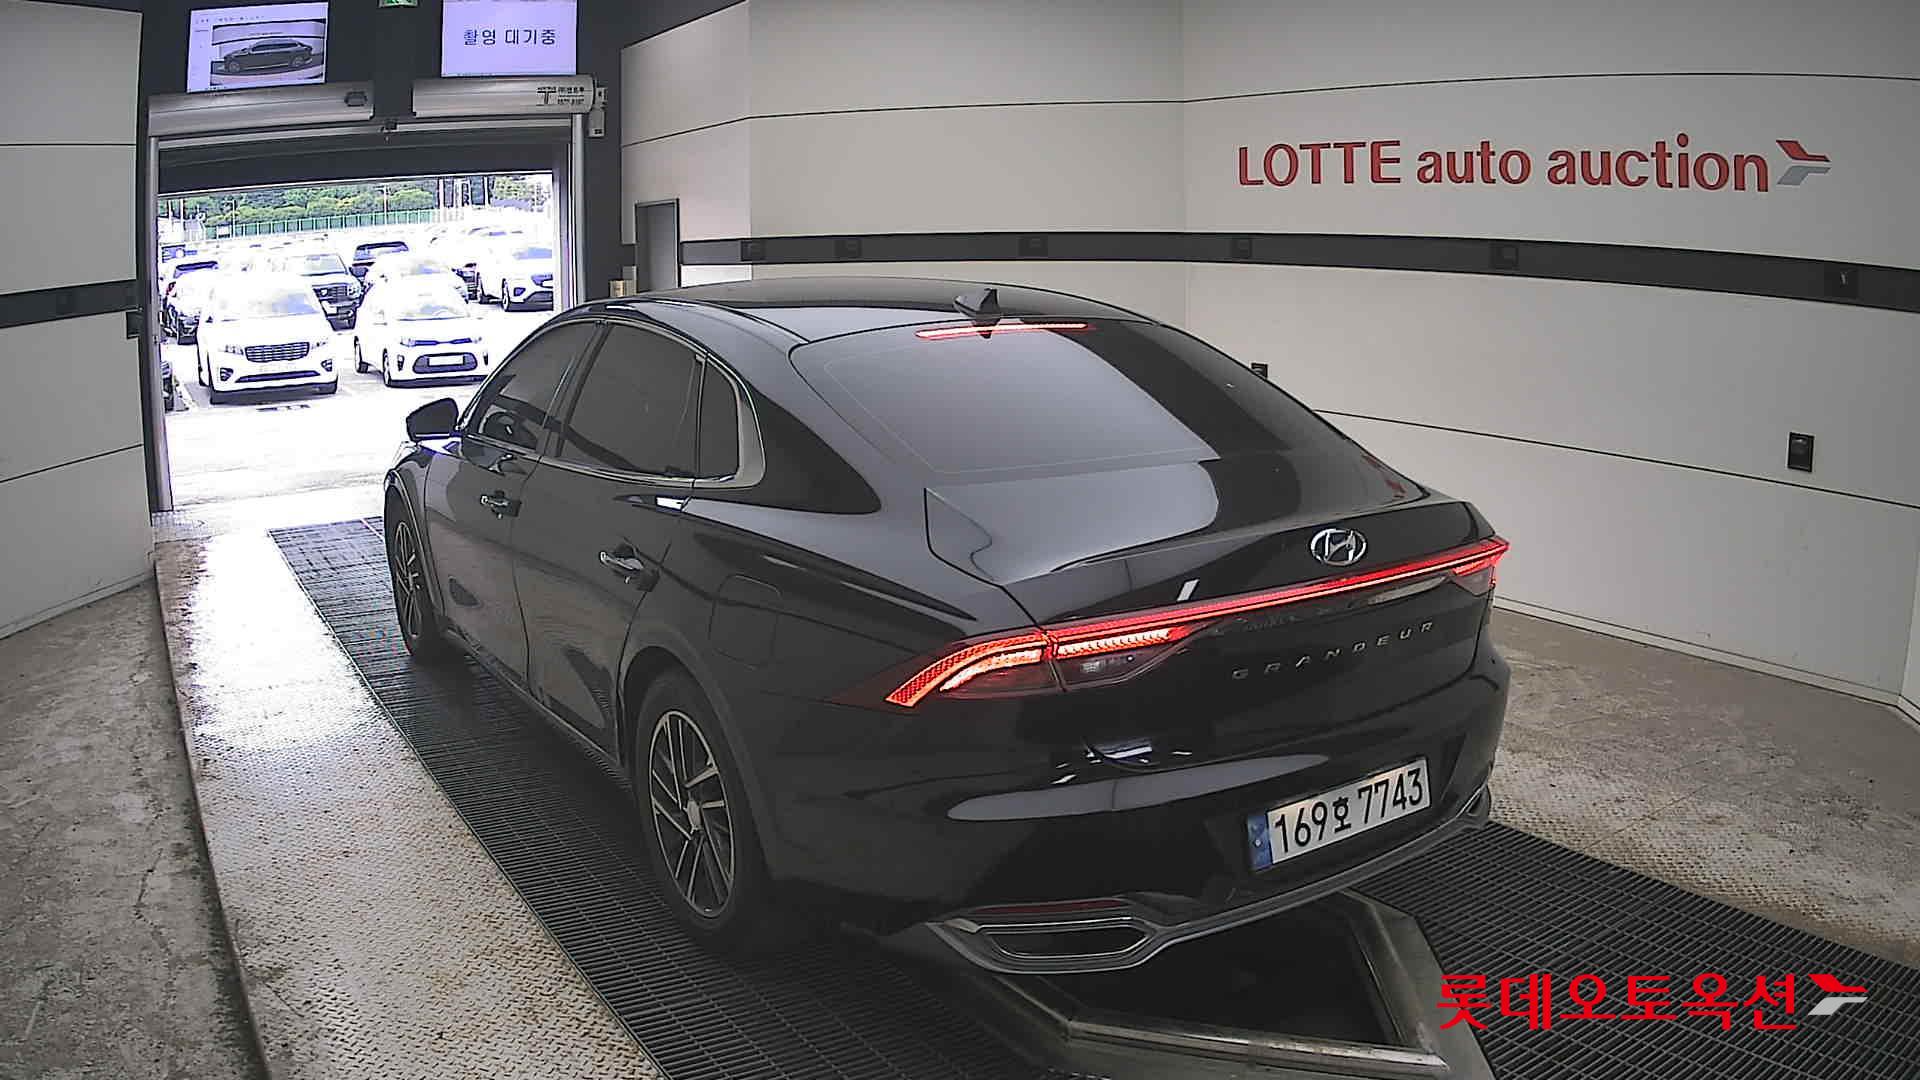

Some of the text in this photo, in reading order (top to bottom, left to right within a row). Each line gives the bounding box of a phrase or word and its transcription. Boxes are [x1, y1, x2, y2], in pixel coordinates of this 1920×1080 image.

[463, 28, 556, 46] 촬영 대기중
[1239, 133, 1770, 193] LOTTE auto auction
[1231, 620, 1434, 680] GRANDEUR
[1273, 766, 1424, 854] 169호 7743
